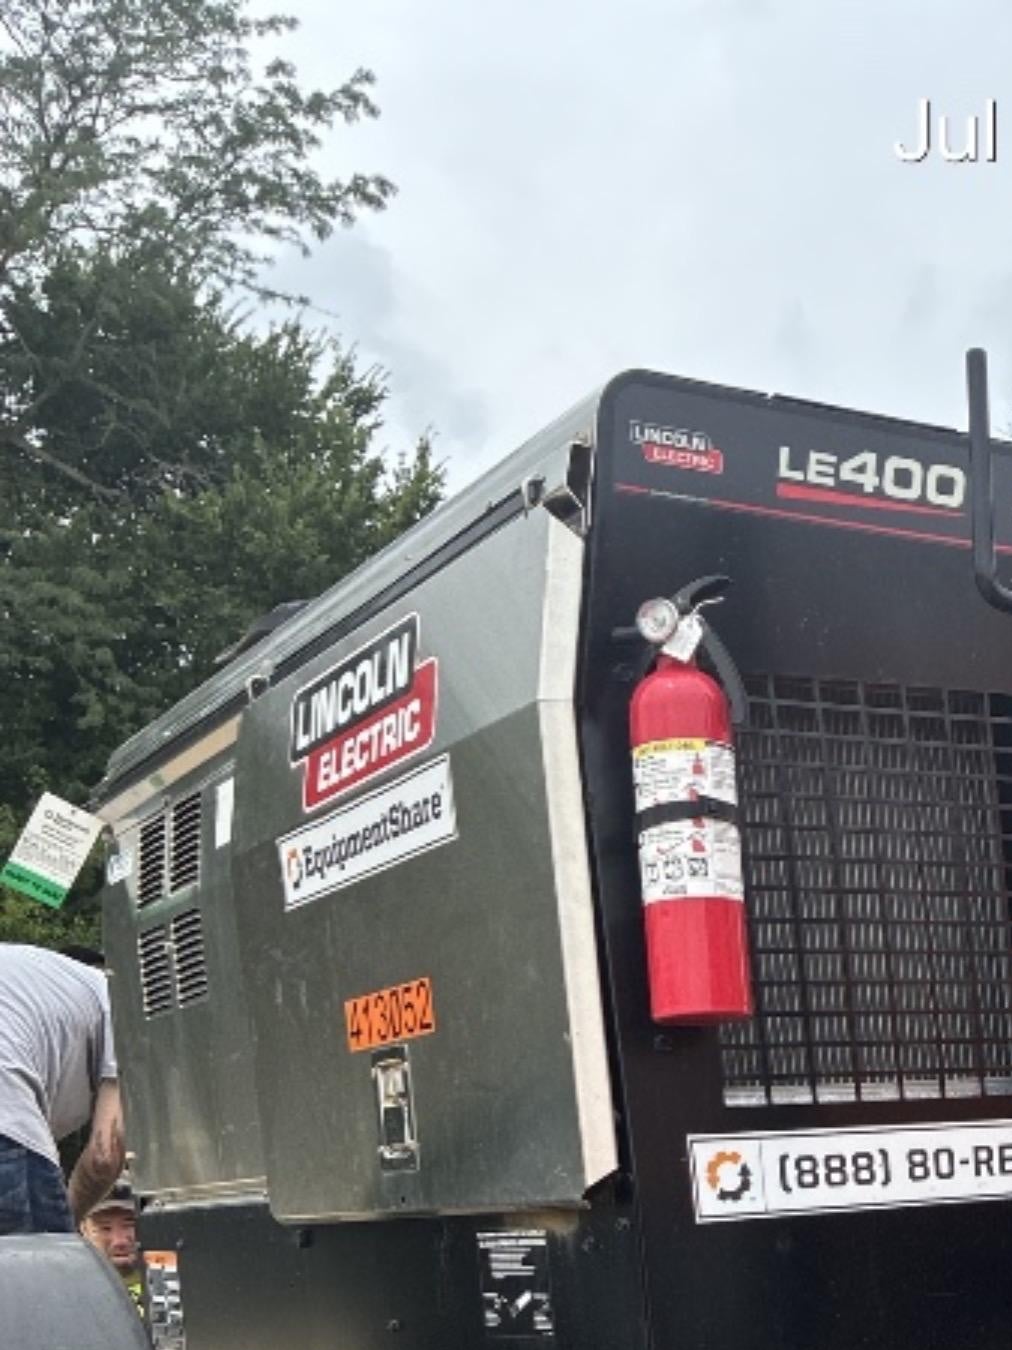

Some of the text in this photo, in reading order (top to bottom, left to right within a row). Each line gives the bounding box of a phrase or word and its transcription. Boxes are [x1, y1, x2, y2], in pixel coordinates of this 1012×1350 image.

[635, 424, 706, 451] LINCOLN
[778, 446, 966, 508] LE400
[295, 631, 411, 751] LINCOLN
[316, 697, 421, 793] ELECTRIC
[302, 792, 442, 880] EquipmentShare
[350, 979, 433, 1045] 413052
[777, 1148, 893, 1194] (888)
